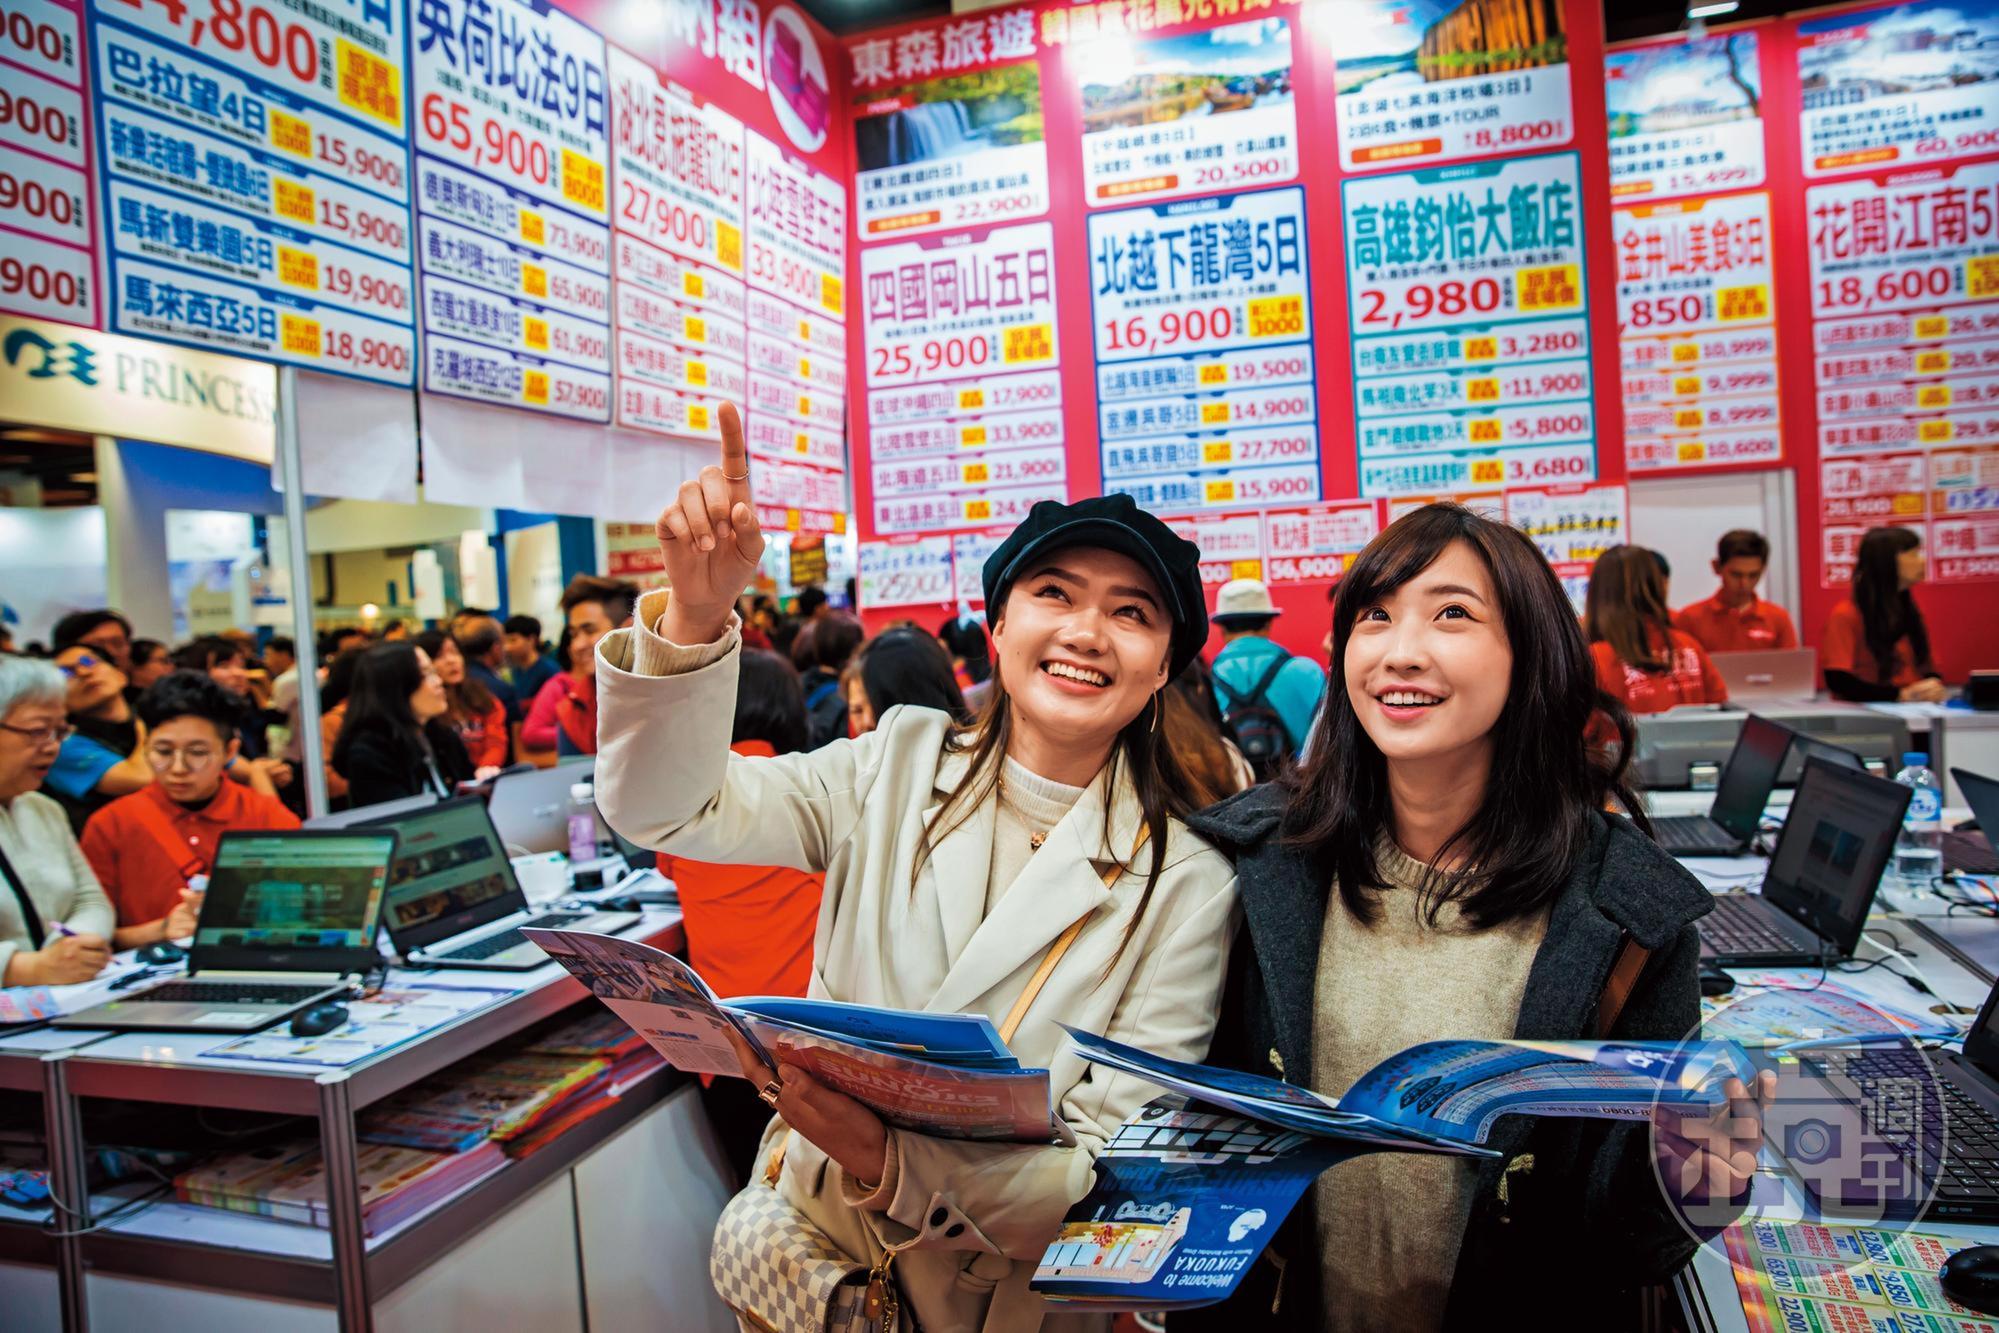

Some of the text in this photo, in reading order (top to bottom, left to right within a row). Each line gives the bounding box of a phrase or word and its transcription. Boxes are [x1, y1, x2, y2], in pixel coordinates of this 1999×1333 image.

[118, 0, 318, 83] ,800
[852, 10, 1036, 87] 東森旅遊
[107, 42, 267, 134] 巴拉望4日
[422, 92, 548, 185] 65,900
[316, 133, 400, 188] 15,900
[1195, 159, 1280, 187] 20,500
[320, 199, 402, 250] 15,900
[623, 180, 705, 248] 27,900
[955, 195, 1031, 221] 22,900
[1351, 179, 1575, 270] 高雄鈞怡大飯店
[1813, 186, 1999, 260] 花開江南5
[549, 221, 605, 261] 73,900
[1097, 215, 1301, 296] 北越下龍灣5日
[1, 258, 77, 306] 900
[323, 264, 403, 311] 19,900
[551, 274, 606, 311] 65,900
[752, 243, 814, 300] 33,900
[868, 248, 1050, 324] 四國岡山五日
[1819, 267, 1950, 309] 18,600
[124, 273, 278, 342] 馬來西亞5日
[1360, 278, 1500, 329] 2,980
[324, 329, 405, 372] 18,900
[1105, 306, 1232, 352] 16,900
[1502, 331, 1577, 357] 3,280
[873, 335, 988, 382] 25,900
[1233, 358, 1300, 382] 19,500
[554, 379, 607, 410] 57,900
[992, 384, 1051, 407] 17,900
[1234, 398, 1302, 422] 14,900
[1240, 437, 1307, 462] 27,700
[1508, 455, 1584, 480] 3,680
[1238, 477, 1308, 502] 15,900
[1173, 1255, 1249, 1272] FUKUOKA
[1858, 1229, 1891, 1265] 12,800
[1162, 1273, 1234, 1289] Welcome to
[1767, 1257, 1791, 1291] 65,900
[1779, 1296, 1808, 1333] 22,900
